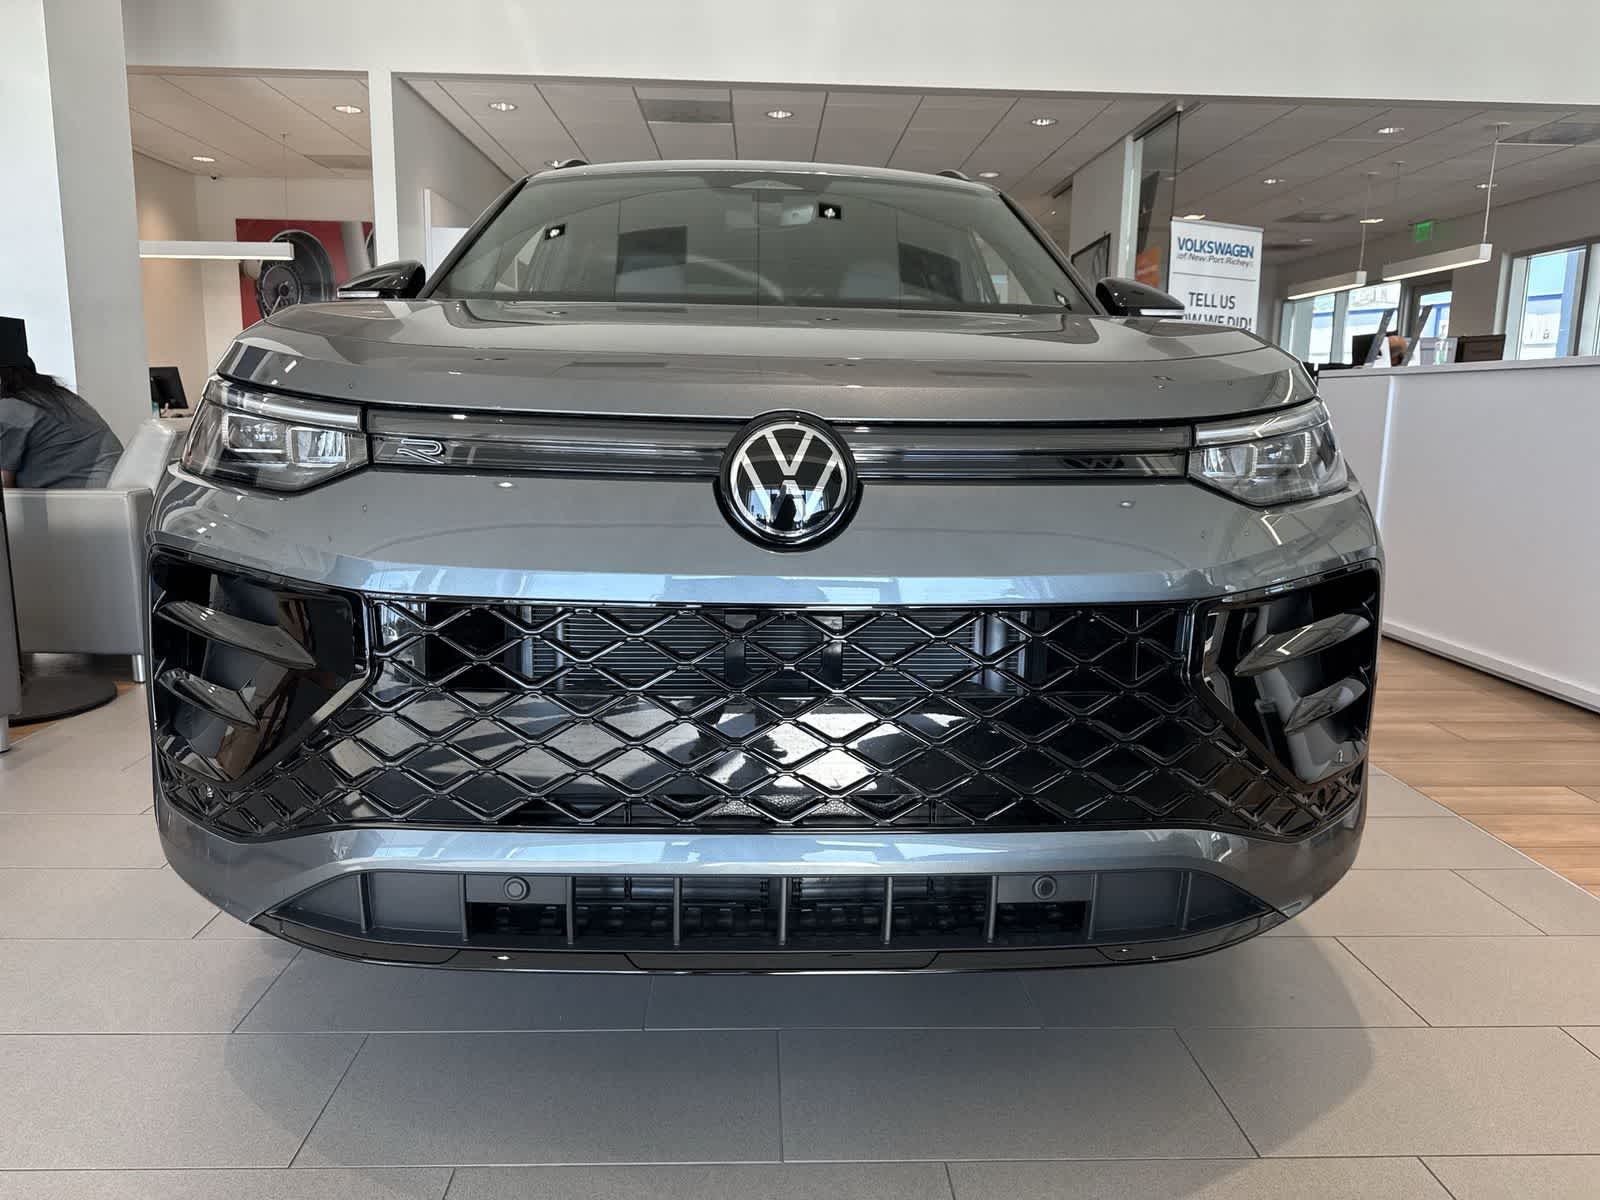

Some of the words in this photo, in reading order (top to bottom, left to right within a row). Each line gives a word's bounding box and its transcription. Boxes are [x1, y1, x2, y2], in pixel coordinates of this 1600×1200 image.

[1177, 237, 1254, 258] VOLKSWAGEN
[1189, 253, 1206, 261] New
[1208, 255, 1225, 264] Port
[1188, 292, 1217, 308] TELL
[1220, 295, 1236, 309] US
